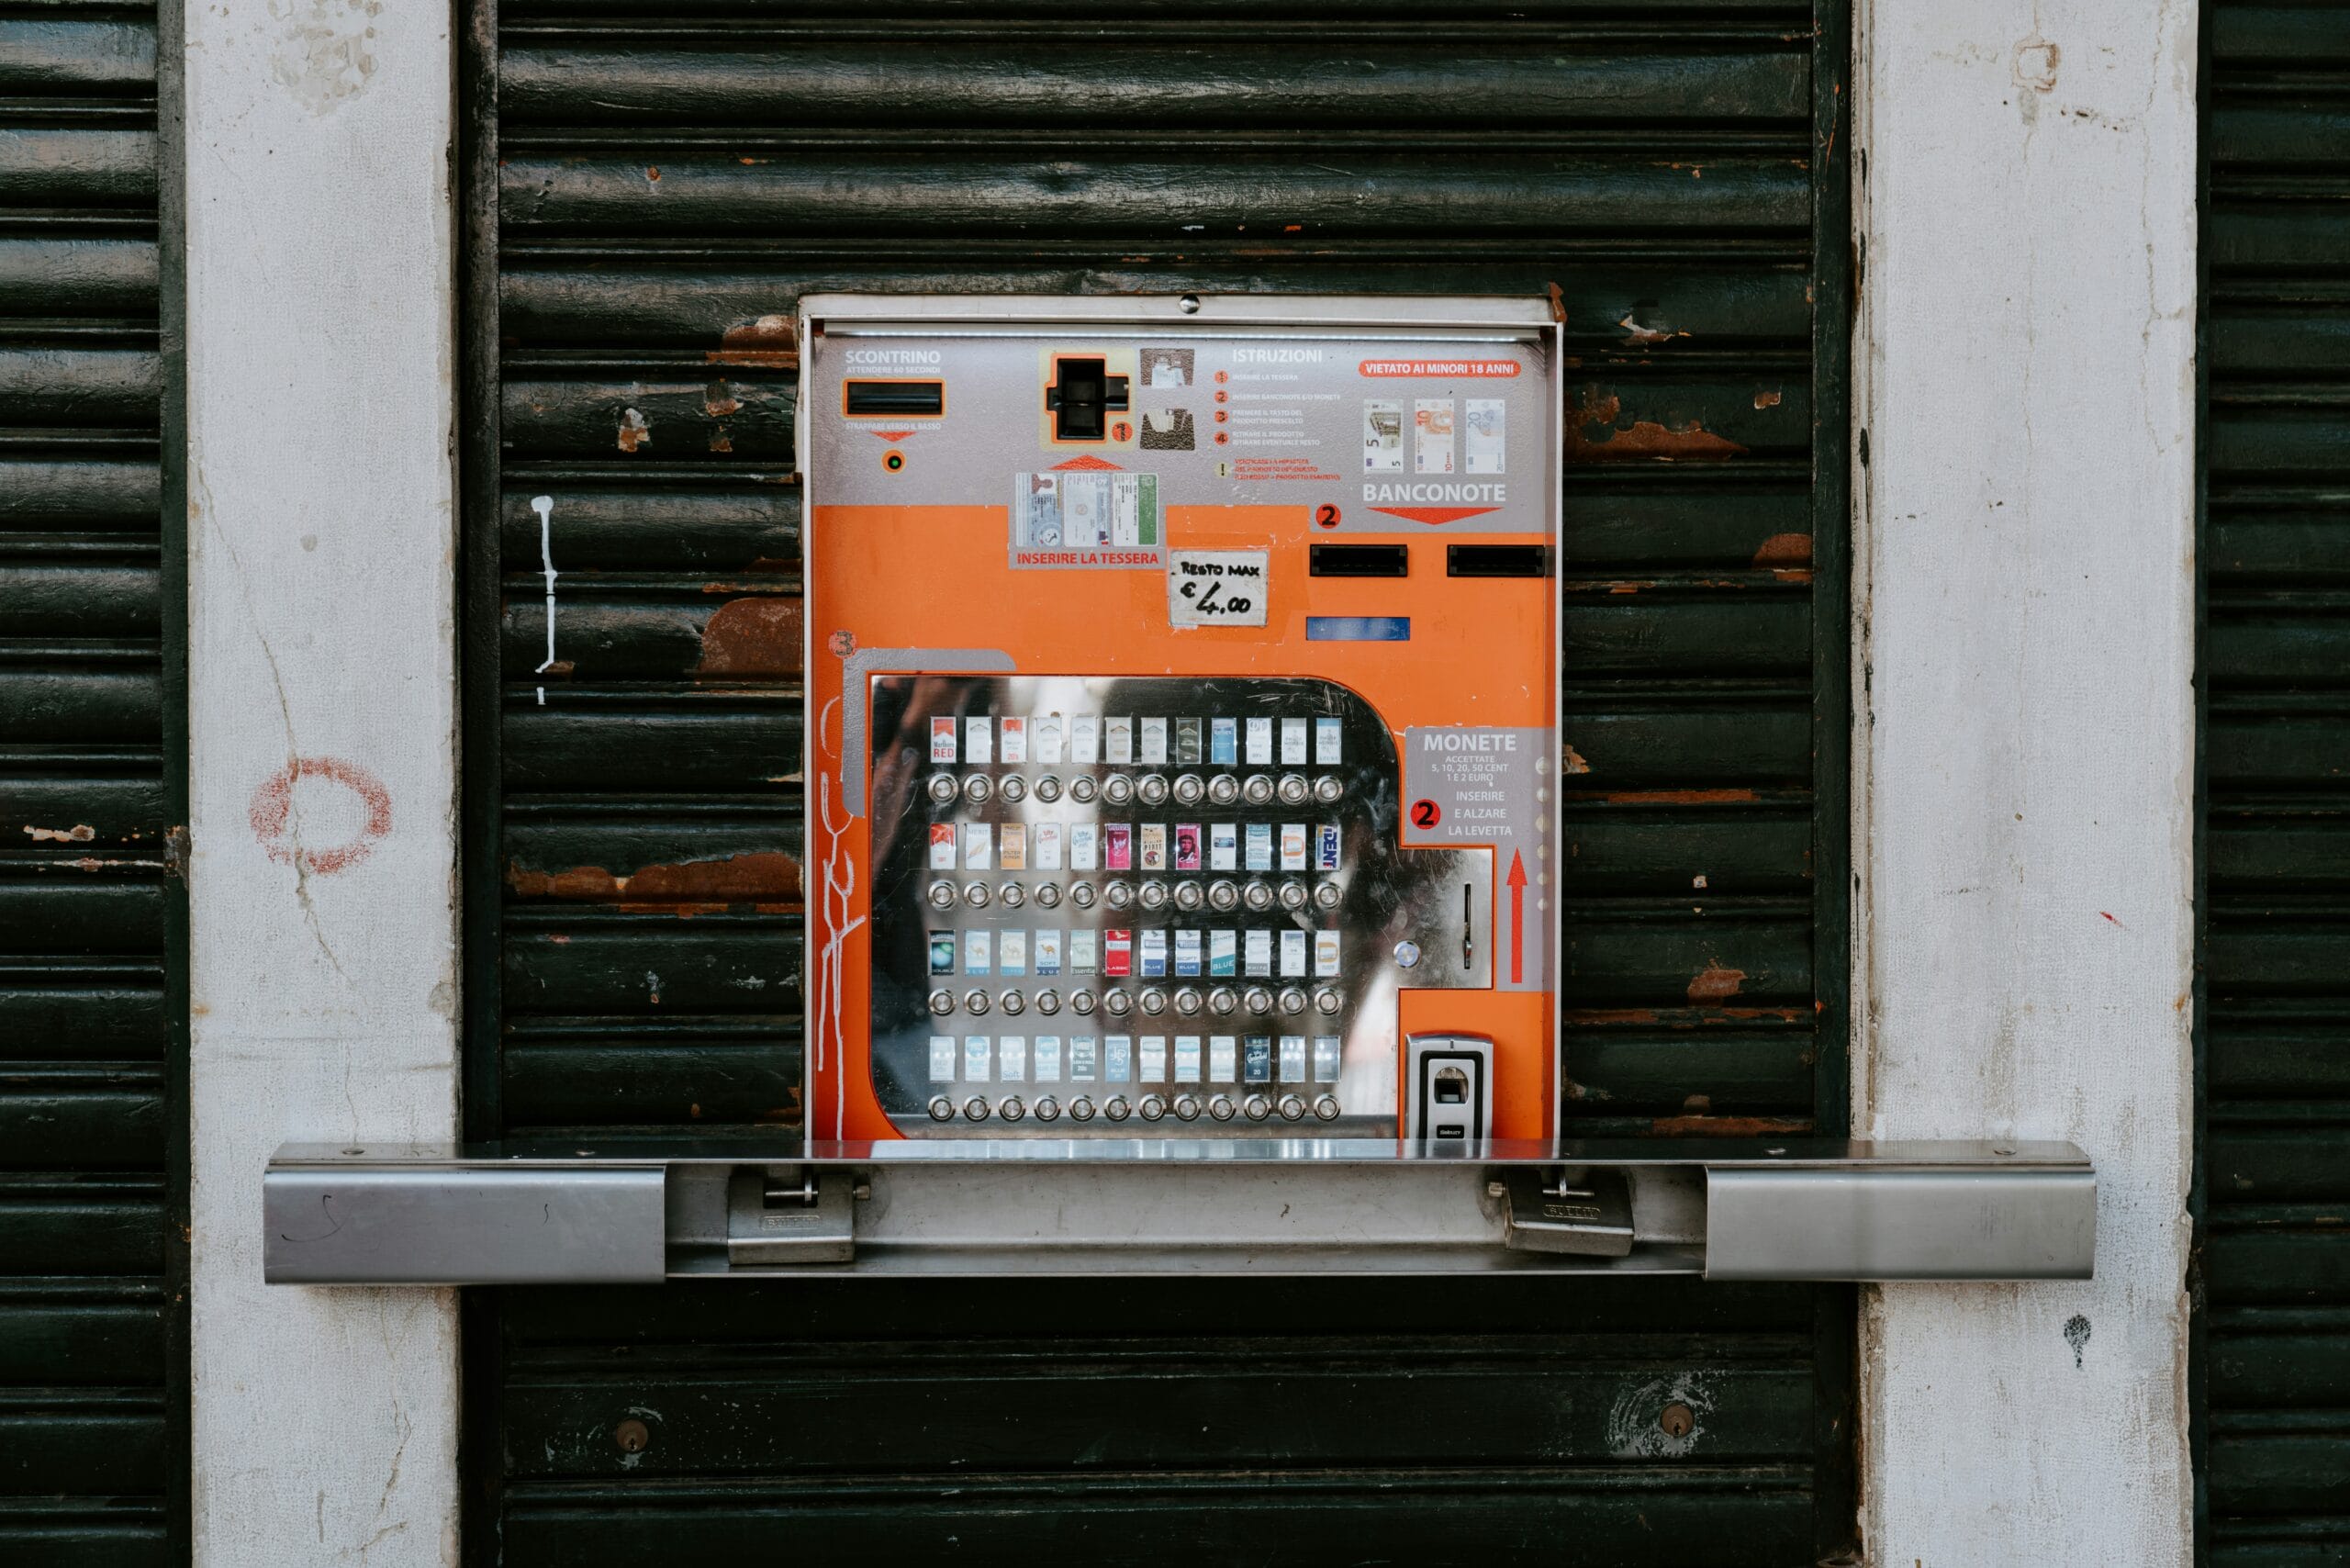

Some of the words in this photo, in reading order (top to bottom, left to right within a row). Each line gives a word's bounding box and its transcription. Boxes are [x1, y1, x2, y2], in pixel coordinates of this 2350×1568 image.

[845, 350, 941, 364] SCONTRINO
[1233, 349, 1323, 364] ISTRUZIONI
[1365, 363, 1411, 374] VIETATO
[1413, 363, 1426, 374] AI
[1427, 363, 1468, 374] MINORI
[1471, 364, 1483, 374] 18
[1486, 363, 1514, 374] ANNI
[1218, 392, 1225, 402] 2
[1218, 433, 1225, 444] 4
[1363, 484, 1506, 502] BANCONOTE
[1322, 506, 1336, 525] 2
[1017, 553, 1078, 565] INSERIRE
[1080, 553, 1098, 565] LA
[1101, 553, 1159, 565] TESSERA
[1181, 561, 1224, 576] RESTO
[1227, 565, 1260, 577] MAX
[836, 631, 853, 655] 3
[1424, 734, 1516, 751] MONETE
[934, 748, 955, 757] RED
[1431, 764, 1439, 774] 5,
[1442, 764, 1454, 774] 10,
[1457, 764, 1470, 774] 20,
[1472, 764, 1483, 772] 50
[1485, 764, 1509, 772] CENT
[1447, 773, 1451, 781] 1
[1454, 773, 1459, 781] E
[1460, 773, 1467, 781] 2
[1469, 773, 1494, 781] EURO
[1456, 791, 1505, 801] INSERIRE
[1416, 801, 1435, 825] 2
[1454, 809, 1461, 818] E
[1463, 809, 1506, 818] ALZARE
[1449, 826, 1463, 835] LA
[1465, 826, 1513, 835] LEVETTA
[1213, 959, 1235, 970] BLUE
